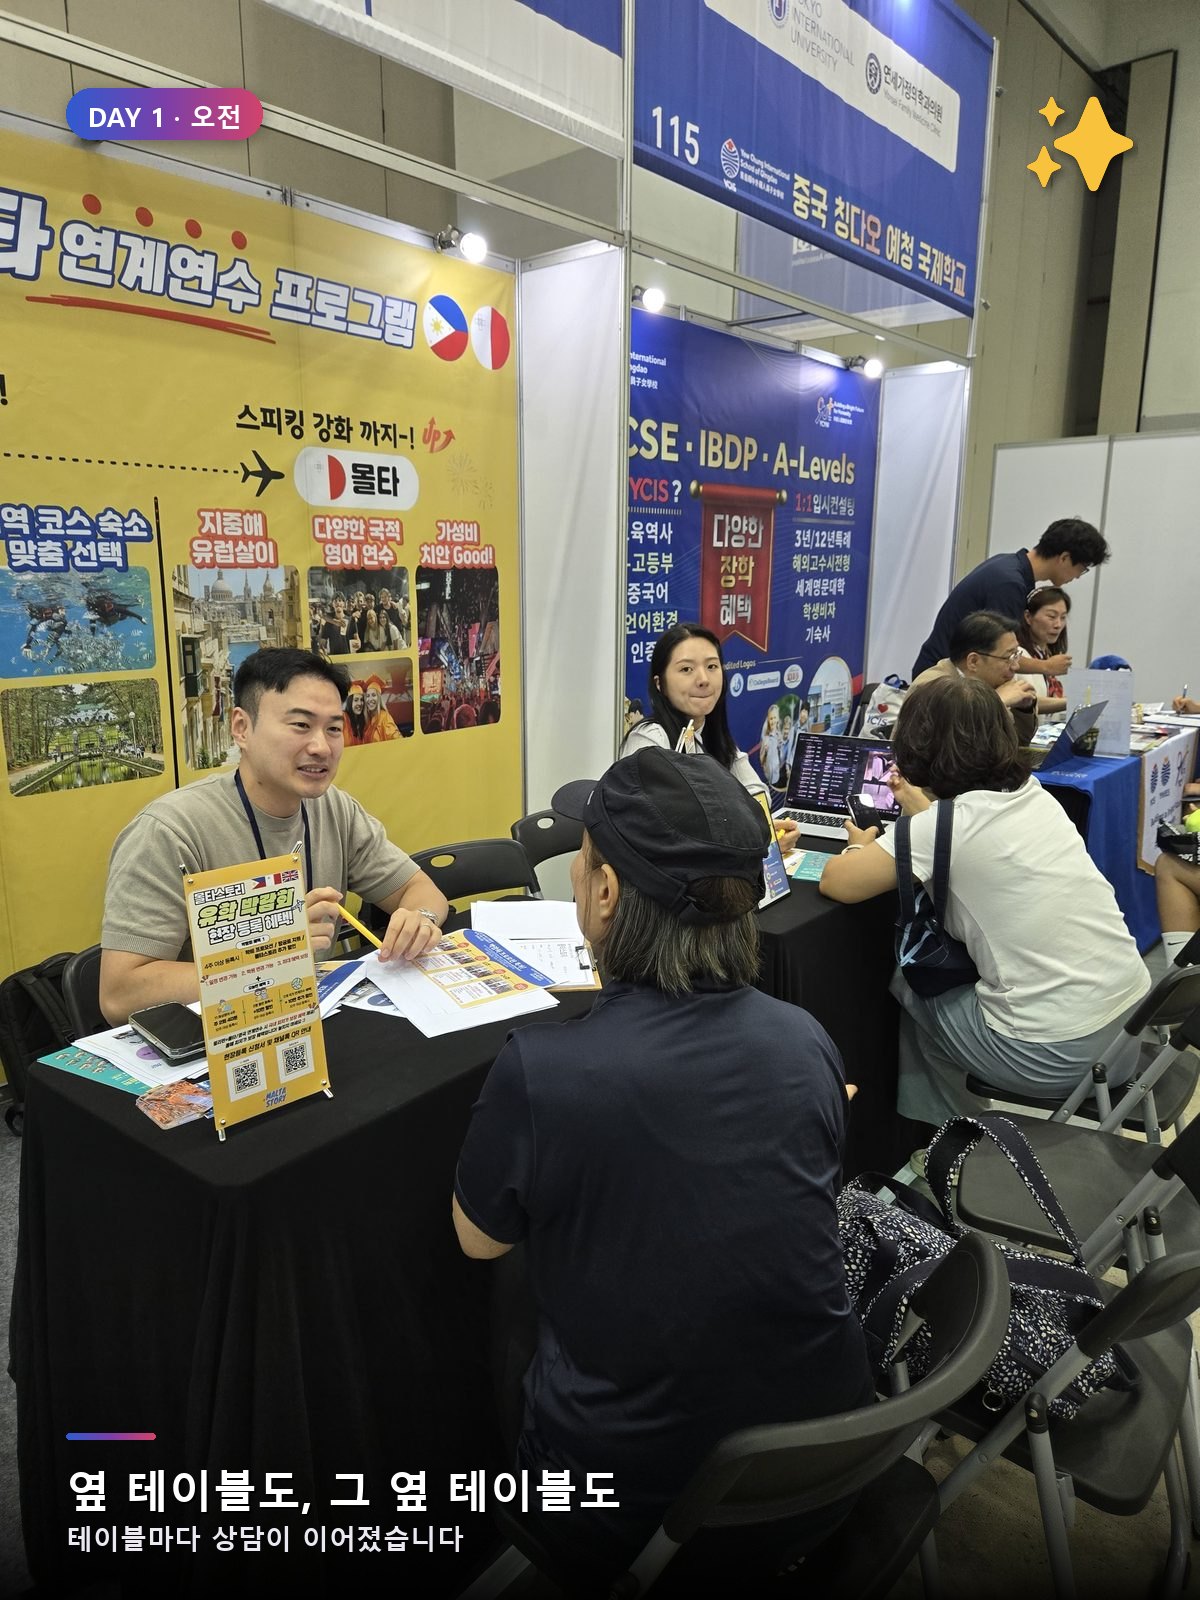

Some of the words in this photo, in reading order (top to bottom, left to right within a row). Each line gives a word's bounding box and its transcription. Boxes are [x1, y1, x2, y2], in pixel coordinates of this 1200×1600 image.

[790, 28, 838, 72] UNIVERSITY
[793, 7, 854, 67] INTERNATIONAL
[652, 106, 700, 165] 115
[793, 173, 828, 229] 중국
[834, 195, 882, 256] 칭다오
[886, 224, 914, 270] 예청
[918, 241, 967, 298] 국제학교
[61, 221, 261, 313] 연계연수
[271, 268, 418, 349] 프로그램
[235, 404, 304, 440] 스피킹
[312, 412, 353, 443] 강화
[700, 429, 758, 472] IBDP
[773, 442, 855, 485] A-Levels
[351, 462, 400, 497] 몰타
[629, 477, 669, 503] YCIS
[37, 508, 92, 536] 코스
[98, 510, 149, 537] 숙소
[199, 511, 264, 536] 지중해
[313, 517, 366, 541] 다양한
[368, 518, 401, 542] 국적
[436, 521, 478, 542] 가성비
[627, 520, 674, 545] 육역사
[712, 513, 764, 549] 다양한
[192, 539, 275, 564] 유럽살이
[794, 529, 852, 549] 3년/12년특례
[8, 539, 65, 567] 맞춤
[71, 541, 123, 567] 선택
[324, 544, 359, 566] 영어
[362, 544, 395, 566] 연수
[420, 544, 450, 565] 치안
[453, 545, 493, 566] Good!
[627, 552, 674, 574] 고등부
[792, 553, 851, 573] 해외고수시전형
[720, 554, 755, 588] 장학
[627, 581, 669, 604] 중국어
[795, 577, 846, 598] 세계명문대학
[719, 593, 752, 627] 혜택
[803, 601, 836, 621] 학생비자
[805, 624, 831, 644] 기숙사
[198, 900, 238, 928] 유학
[239, 887, 295, 916] 박람회
[208, 924, 236, 945] 현장
[237, 917, 263, 937] 등록
[264, 910, 294, 930] 혜택!
